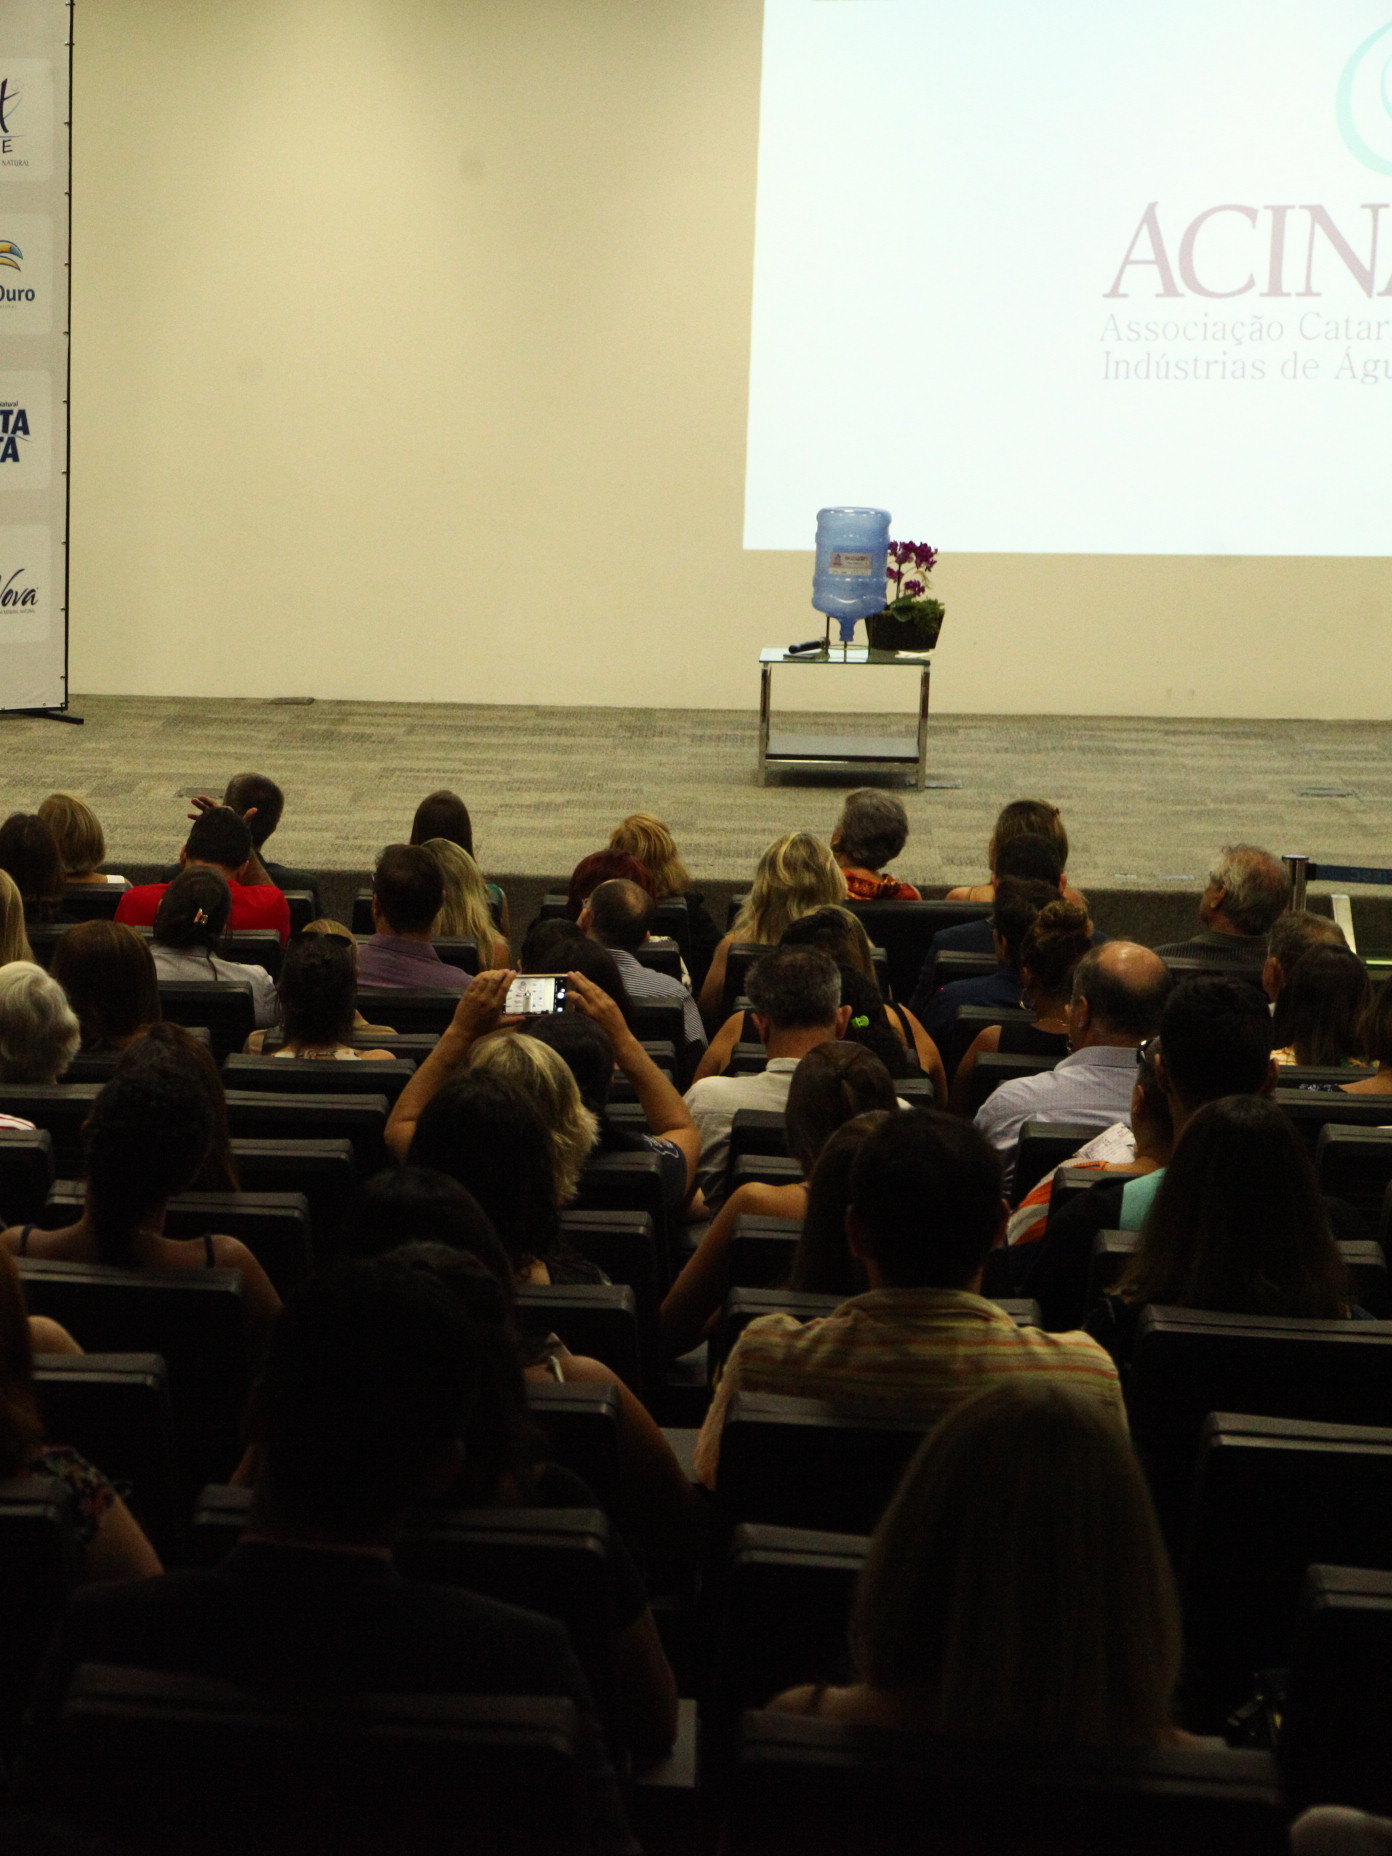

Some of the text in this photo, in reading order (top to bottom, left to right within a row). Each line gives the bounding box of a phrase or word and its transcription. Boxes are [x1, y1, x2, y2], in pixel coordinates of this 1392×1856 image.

[1102, 200, 1392, 299] ACIN
[1099, 313, 1284, 345] Associação
[1102, 350, 1266, 381] Indústrias
[1280, 351, 1320, 380] de
